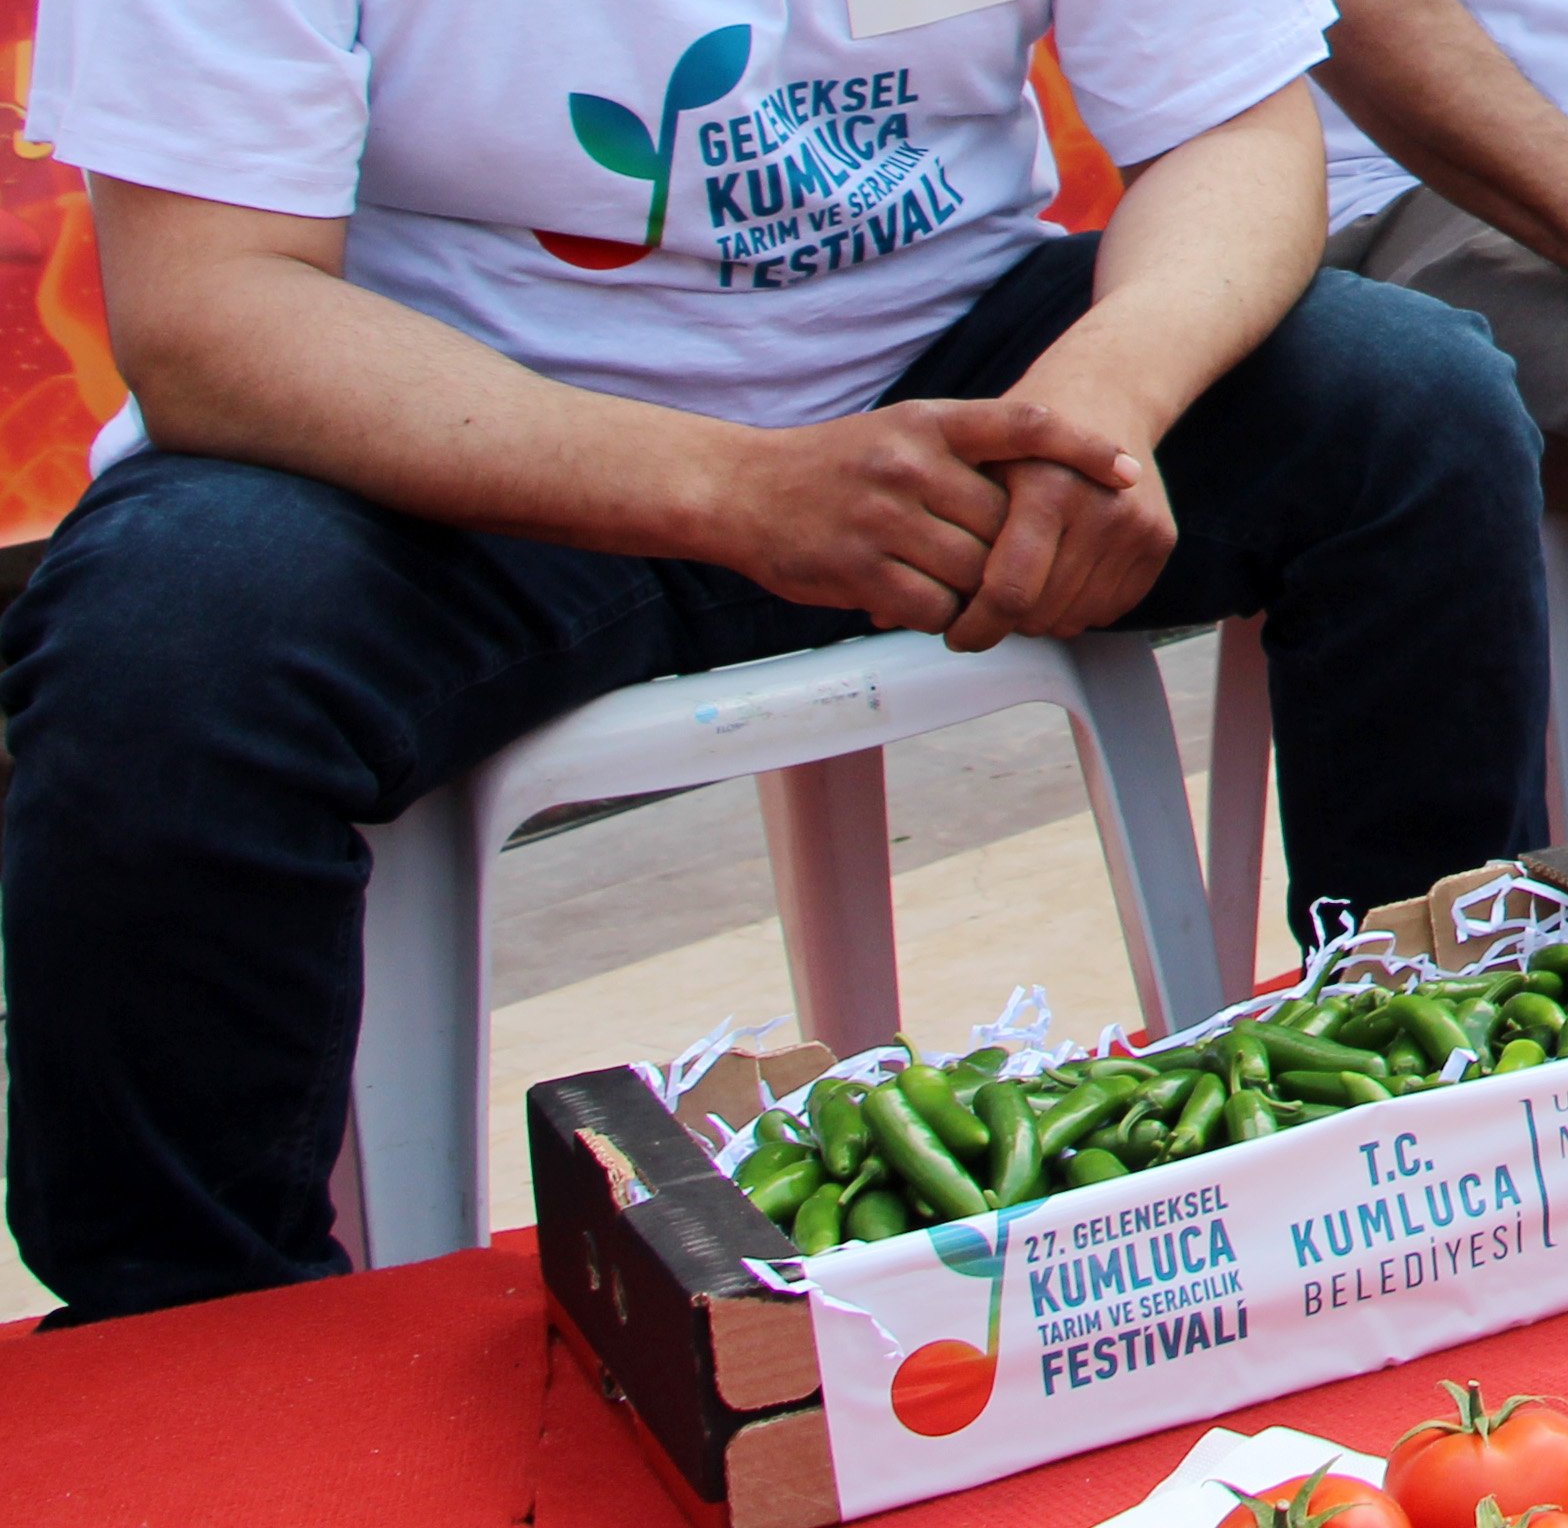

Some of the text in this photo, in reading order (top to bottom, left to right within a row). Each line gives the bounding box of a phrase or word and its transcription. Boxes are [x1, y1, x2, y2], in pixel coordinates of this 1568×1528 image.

[698, 68, 919, 168] GELENEKSEL
[705, 112, 909, 229] KUMLUCA
[716, 140, 929, 261] TARIM VE SERACILIK
[718, 155, 964, 289] FESTİVALİ
[1358, 1131, 1434, 1186] T.C.
[1024, 1183, 1229, 1264] 27. GELENEKSEL
[1290, 1163, 1522, 1269] KUMLUCA
[1304, 1211, 1524, 1317] BELEDİYESİ
[1028, 1217, 1238, 1317] KUMLUCA
[1038, 1269, 1244, 1347] TARIM VE SERACILIK
[1040, 1300, 1250, 1397] FESTİVALİ
